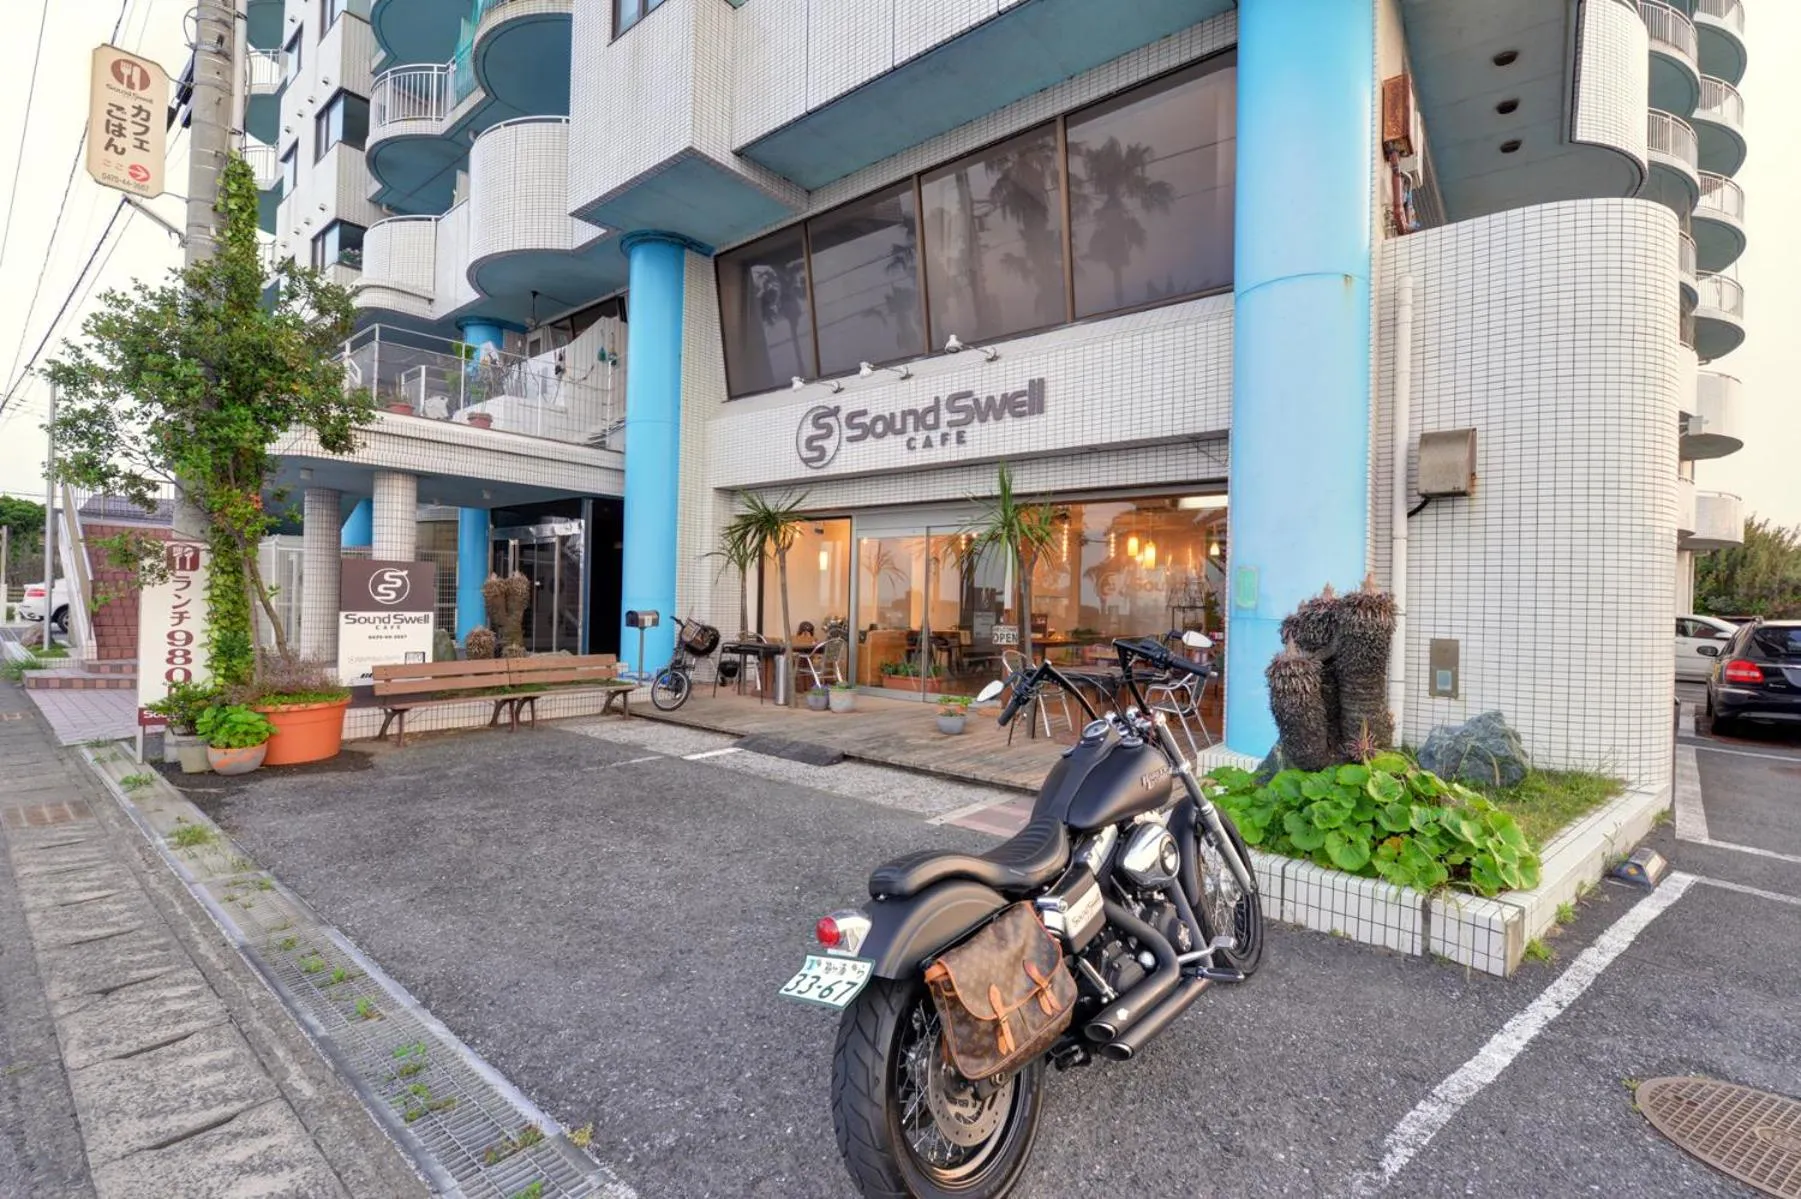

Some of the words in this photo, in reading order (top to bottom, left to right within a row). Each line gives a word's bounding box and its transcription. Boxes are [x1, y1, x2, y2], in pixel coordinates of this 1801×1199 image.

[104, 102, 126, 155] ごはん
[131, 104, 151, 152] カフェ
[845, 395, 940, 442] Sound
[946, 377, 1045, 428] Swell
[906, 430, 967, 451] CAFE
[344, 613, 391, 624] Sound
[393, 613, 430, 624] Swell
[992, 632, 1018, 644] OPEN
